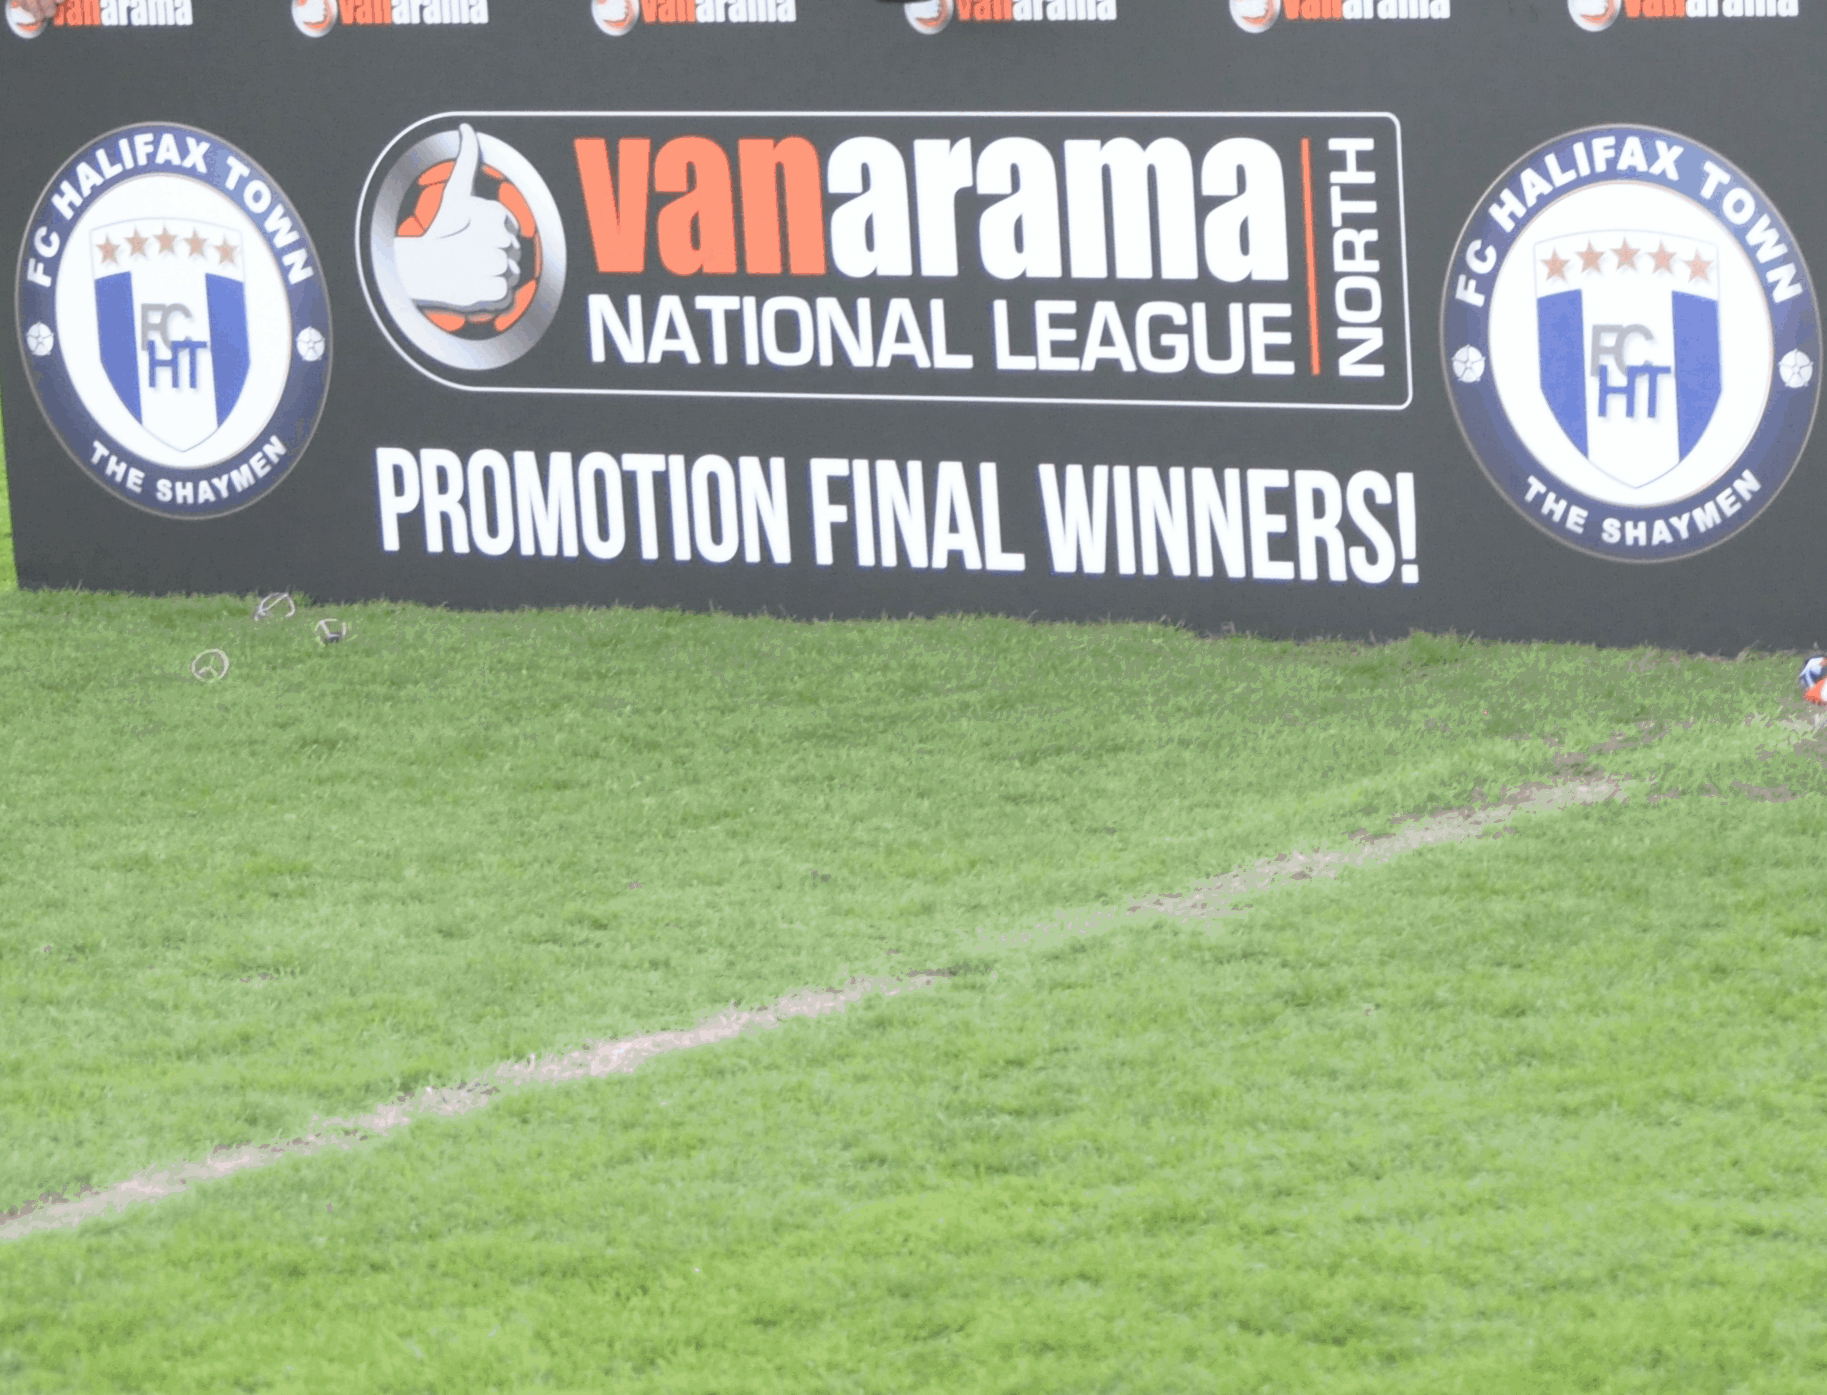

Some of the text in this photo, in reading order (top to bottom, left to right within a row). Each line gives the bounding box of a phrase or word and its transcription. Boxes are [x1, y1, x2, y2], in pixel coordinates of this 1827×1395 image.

[27, 133, 315, 288] FC HALIFAX TOWN
[573, 134, 1386, 379] vanarama NORTH
[1455, 135, 1803, 308] FC HALIFAX TOWN
[587, 293, 1296, 377] NATIONAL LEAGUE
[88, 434, 288, 505] THE SHAYMEN
[375, 446, 1420, 585] PROMOTION FINAL WINNERS!
[1524, 469, 1762, 547] THE SHAYMEN
